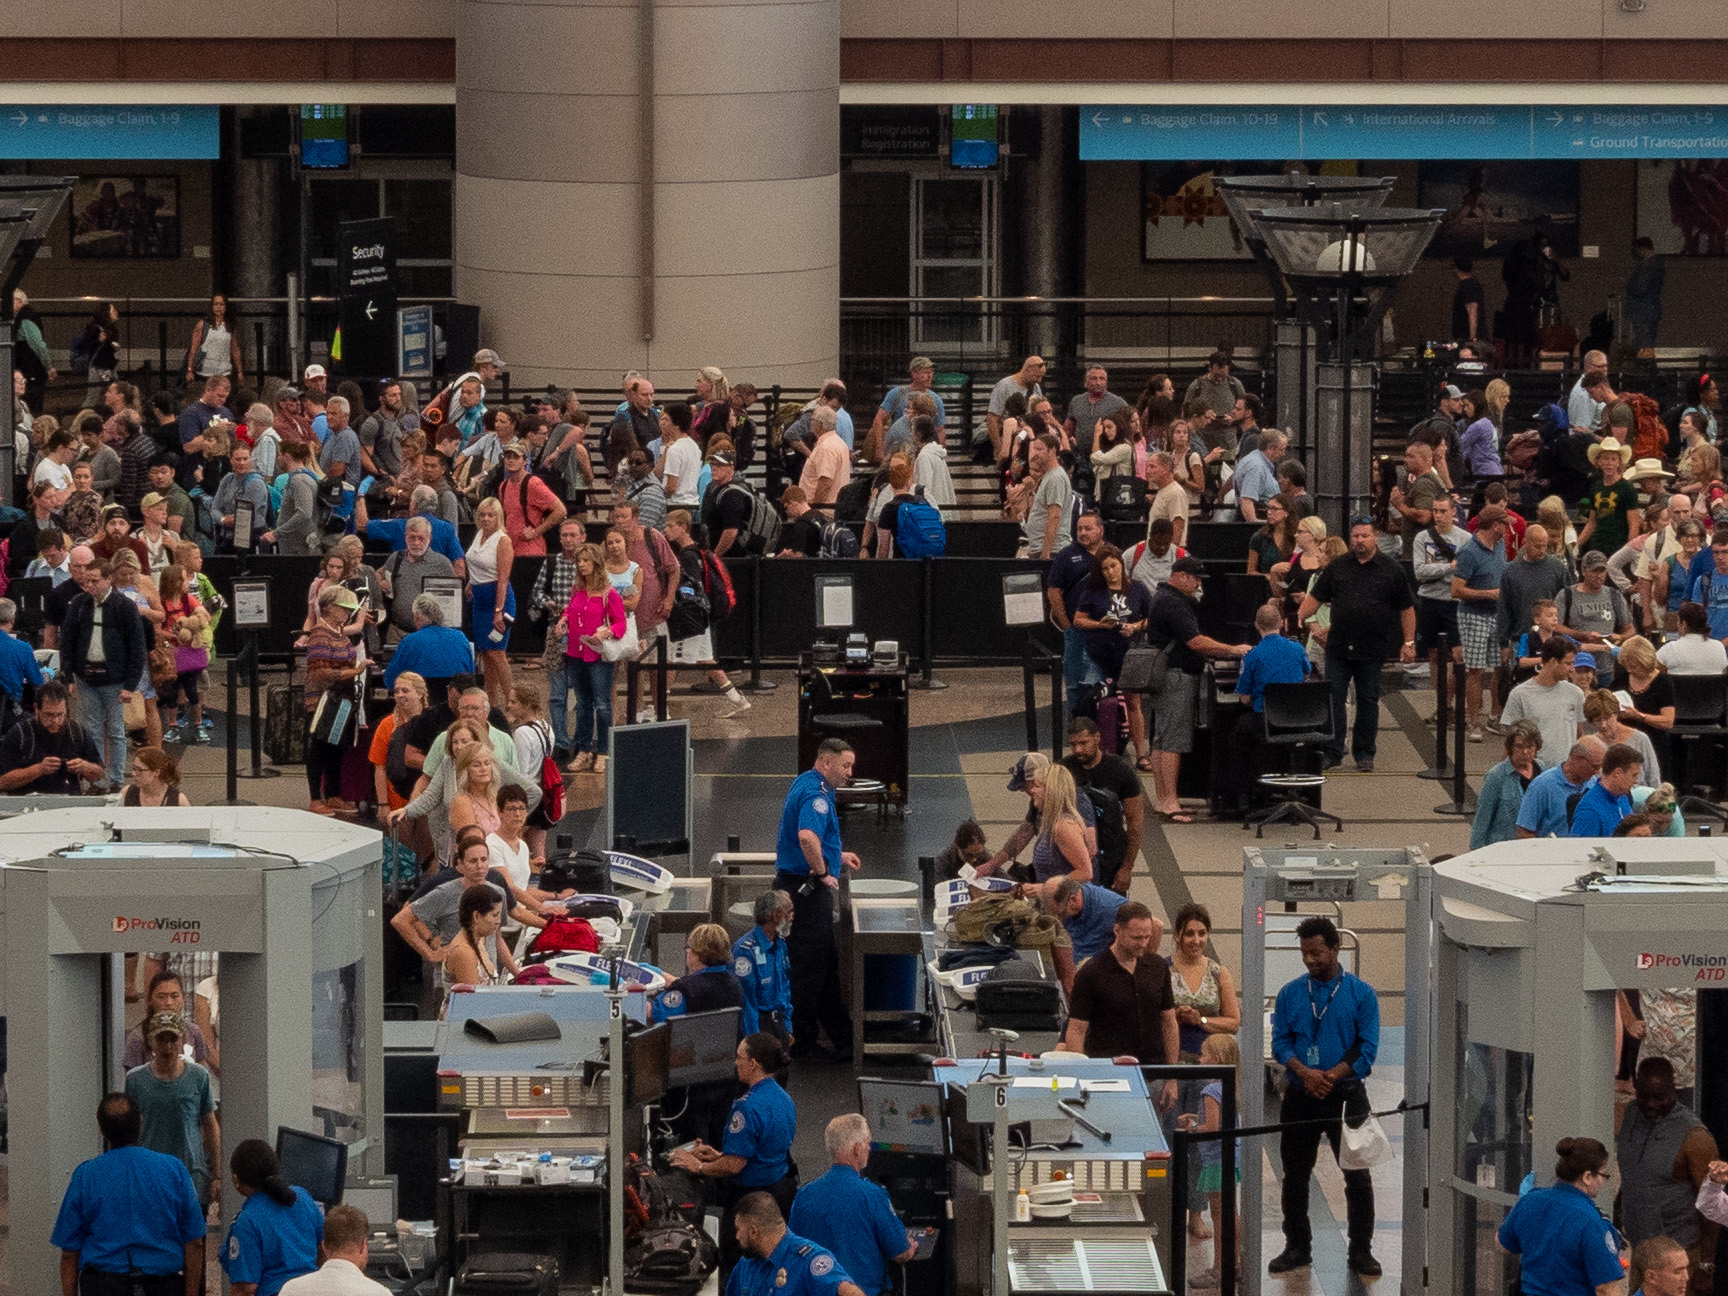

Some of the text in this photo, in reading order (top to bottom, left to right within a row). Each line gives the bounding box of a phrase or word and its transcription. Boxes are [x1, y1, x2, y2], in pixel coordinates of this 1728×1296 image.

[58, 113, 114, 127] Baggage
[161, 112, 180, 124] 1-9
[1140, 113, 1195, 127] Baggage
[1243, 112, 1278, 124] 10-19
[1362, 113, 1496, 125] International Arrivals
[1592, 113, 1648, 127] Baggage
[1694, 112, 1713, 124] 1-9
[1590, 136, 1638, 149] Ground
[352, 244, 385, 259] Security
[130, 917, 201, 930] ProVision
[170, 931, 201, 944] ATD
[1655, 954, 1727, 967] ProVision
[1695, 968, 1726, 981] ATD
[611, 1000, 620, 1018] 5
[996, 1086, 1006, 1107] 6
